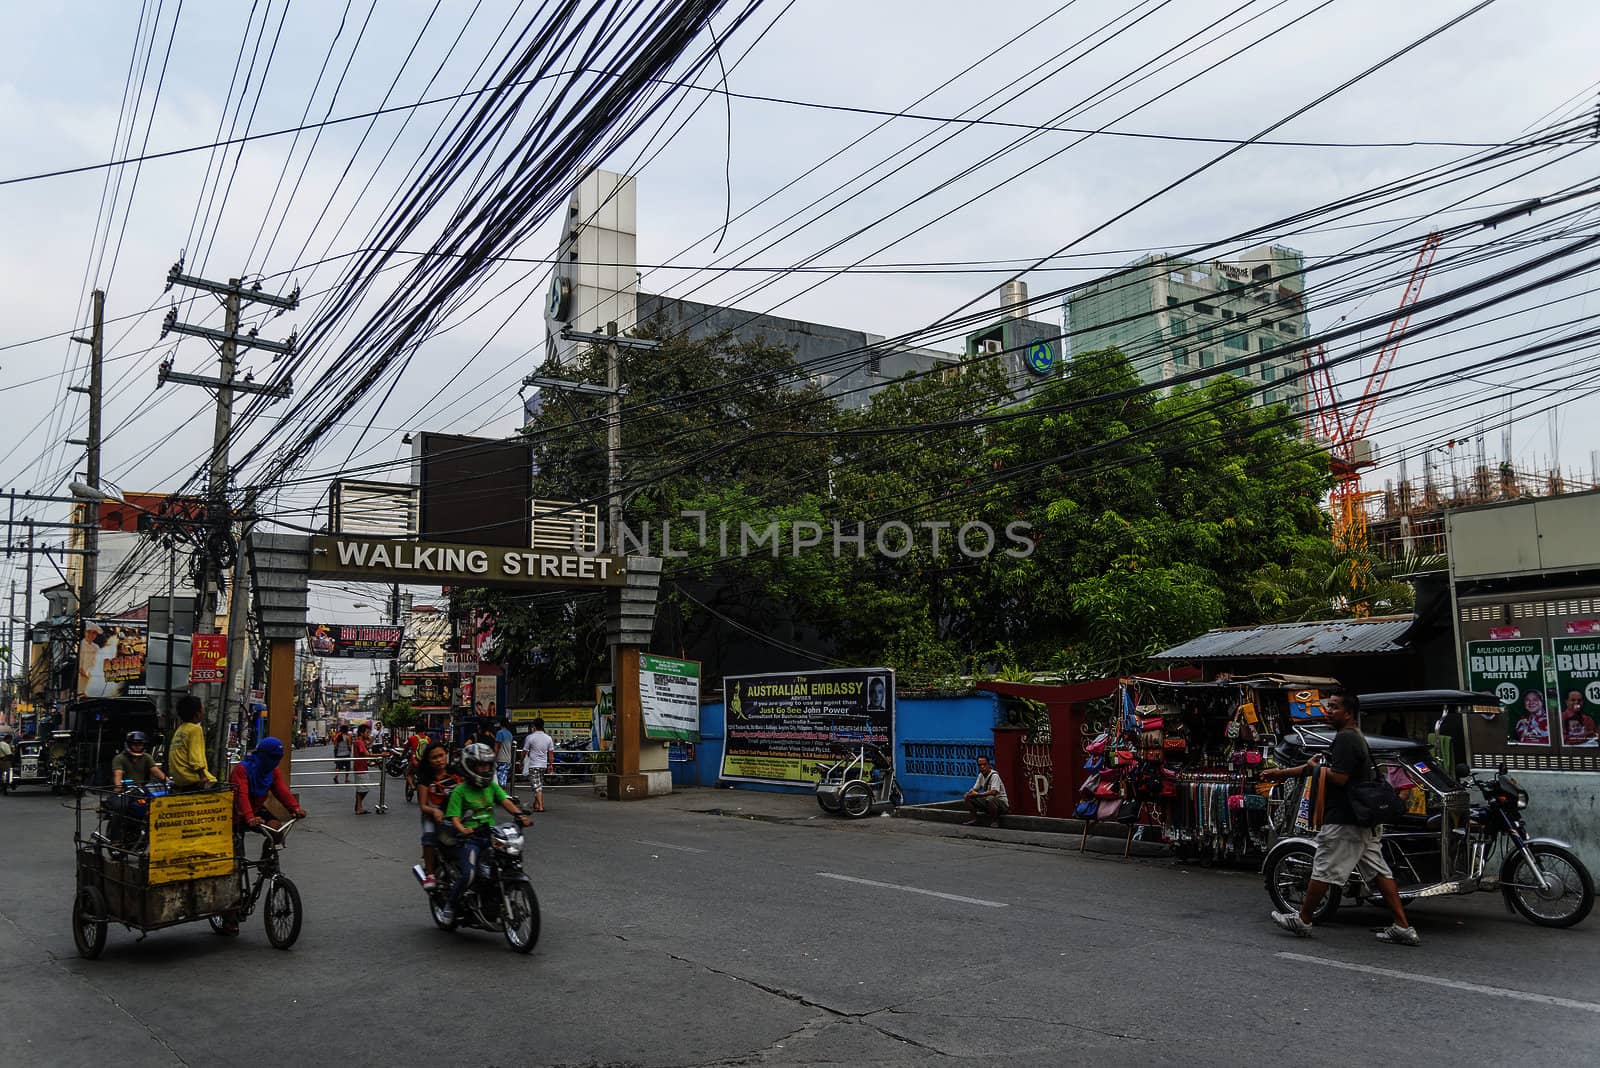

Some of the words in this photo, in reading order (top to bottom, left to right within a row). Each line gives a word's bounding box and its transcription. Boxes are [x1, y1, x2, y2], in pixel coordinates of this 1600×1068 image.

[336, 540, 489, 575] WALKING
[503, 551, 613, 581] STREET
[198, 639, 210, 649] 12
[453, 654, 477, 663] TAILOR
[1471, 655, 1541, 672] BUHAY
[1510, 671, 1528, 679] LIST
[747, 684, 808, 697] AUSTRALIAN
[811, 681, 864, 696] EMBASSY
[1498, 687, 1517, 700] 135
[787, 706, 802, 714] See
[803, 706, 821, 714] John
[823, 706, 850, 714] Power
